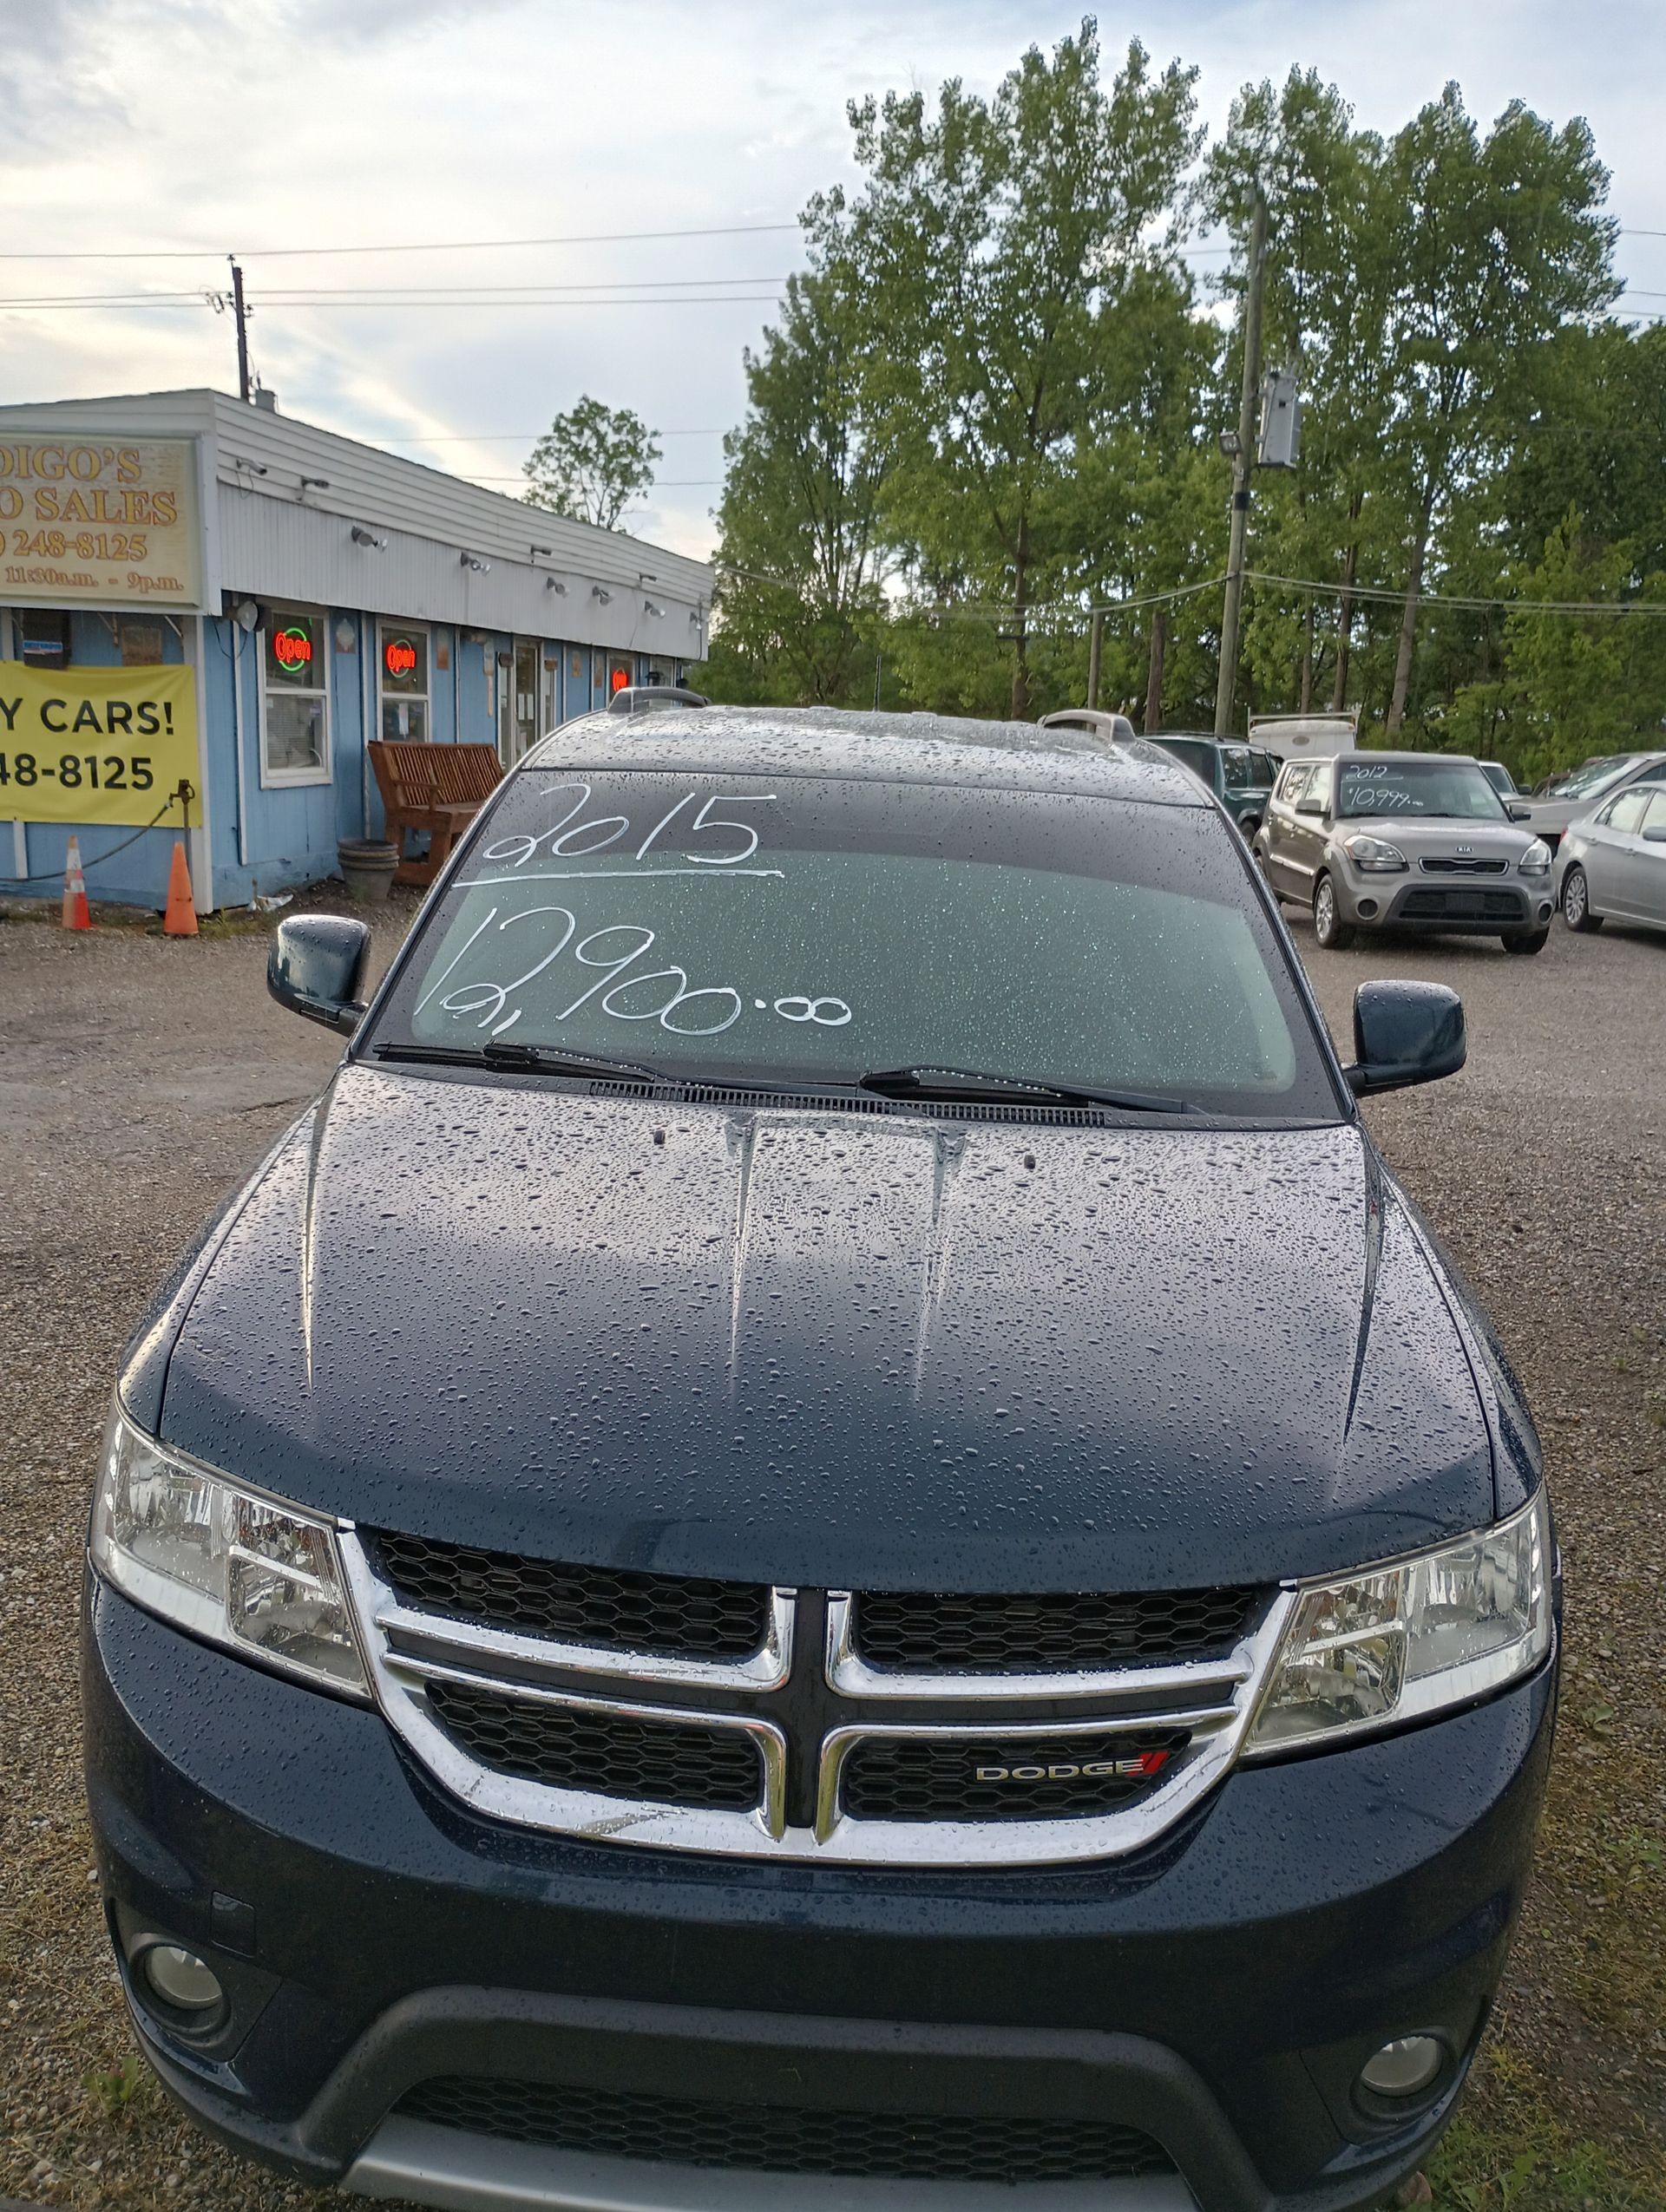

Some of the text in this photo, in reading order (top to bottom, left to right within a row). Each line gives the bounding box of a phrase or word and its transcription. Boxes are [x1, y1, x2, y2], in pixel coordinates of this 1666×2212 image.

[35, 487, 177, 527] SALES
[12, 529, 148, 562] 248-8125
[128, 572, 184, 593] 9p.m.
[275, 632, 312, 663] Open
[387, 645, 416, 672] Open
[0, 697, 174, 736] Y CARS!
[1346, 765, 1387, 779] 2012
[482, 783, 777, 867] 2015
[976, 1758, 1144, 1781] DODGE
